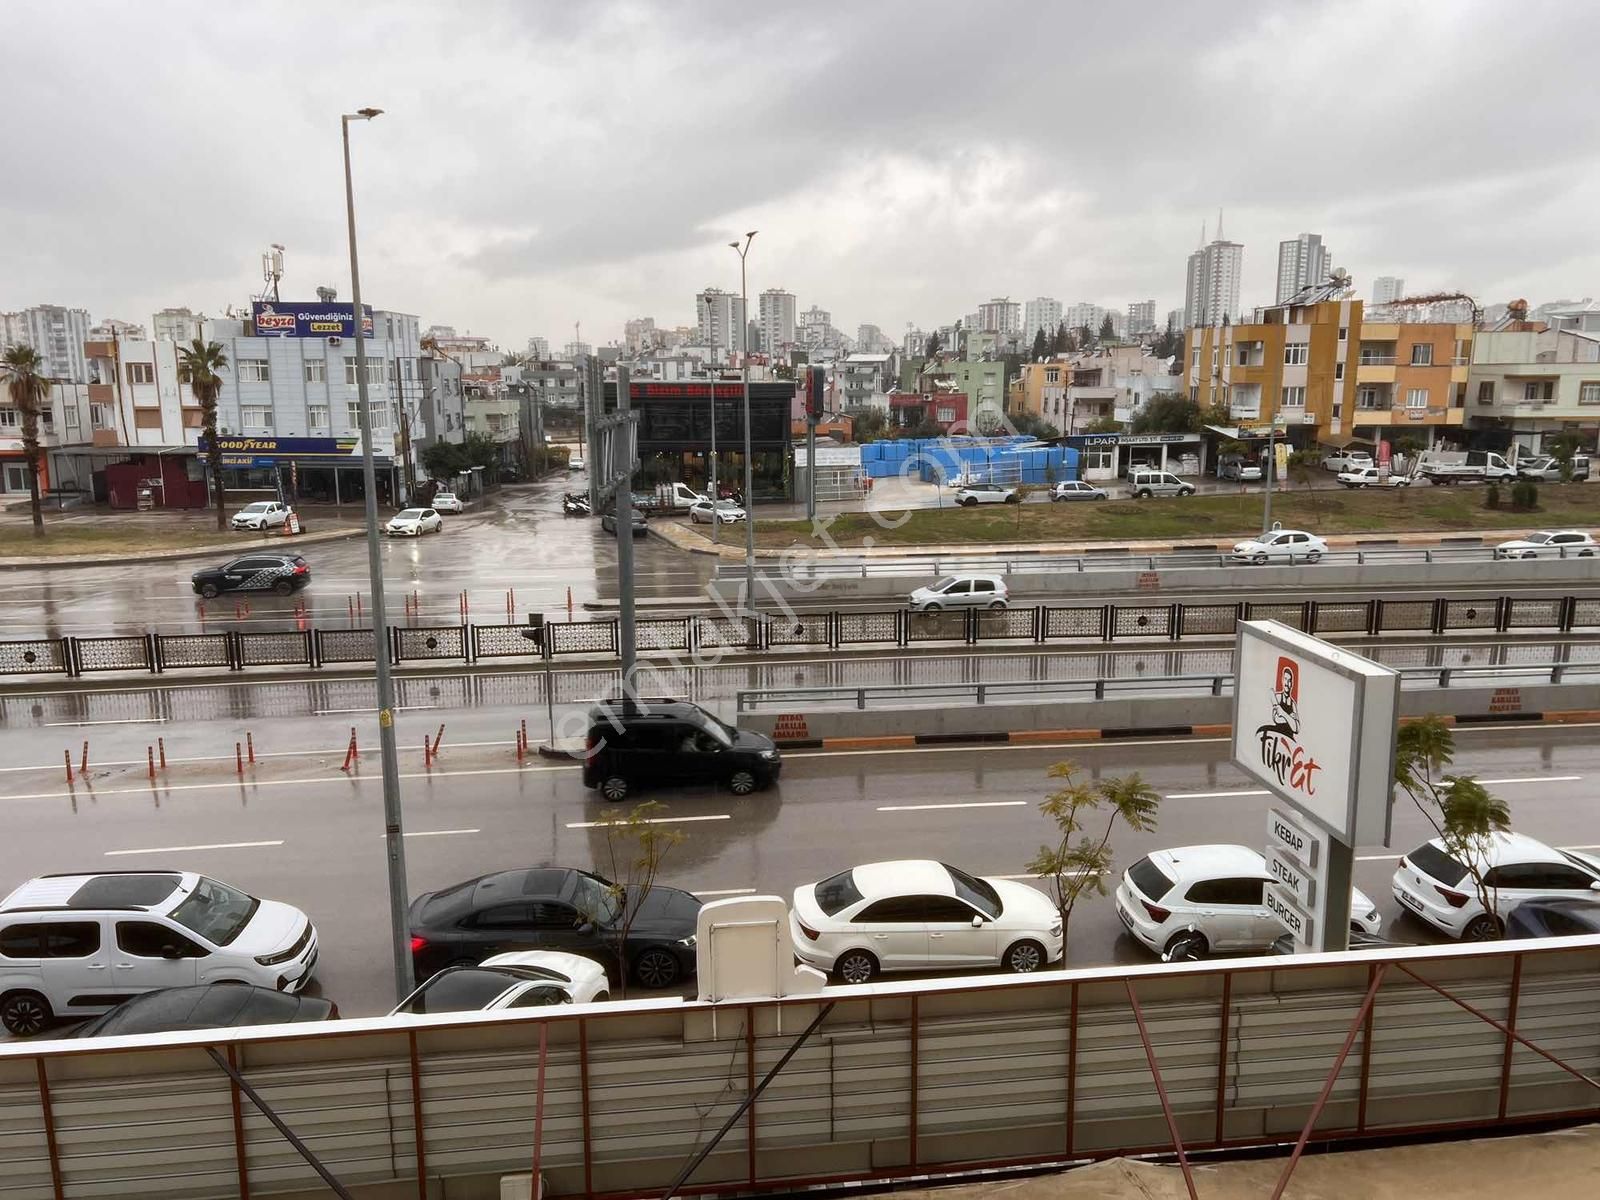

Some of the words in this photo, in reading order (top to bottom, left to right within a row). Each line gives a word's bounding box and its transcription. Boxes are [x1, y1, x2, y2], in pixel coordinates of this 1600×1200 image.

[257, 316, 294, 326] beyza
[298, 313, 353, 322] Güvendiğiniz
[312, 323, 341, 331] Lezzet
[1274, 821, 1303, 851] KEBAP
[1272, 859, 1300, 892] STEAK
[1267, 893, 1301, 934] BURGER
